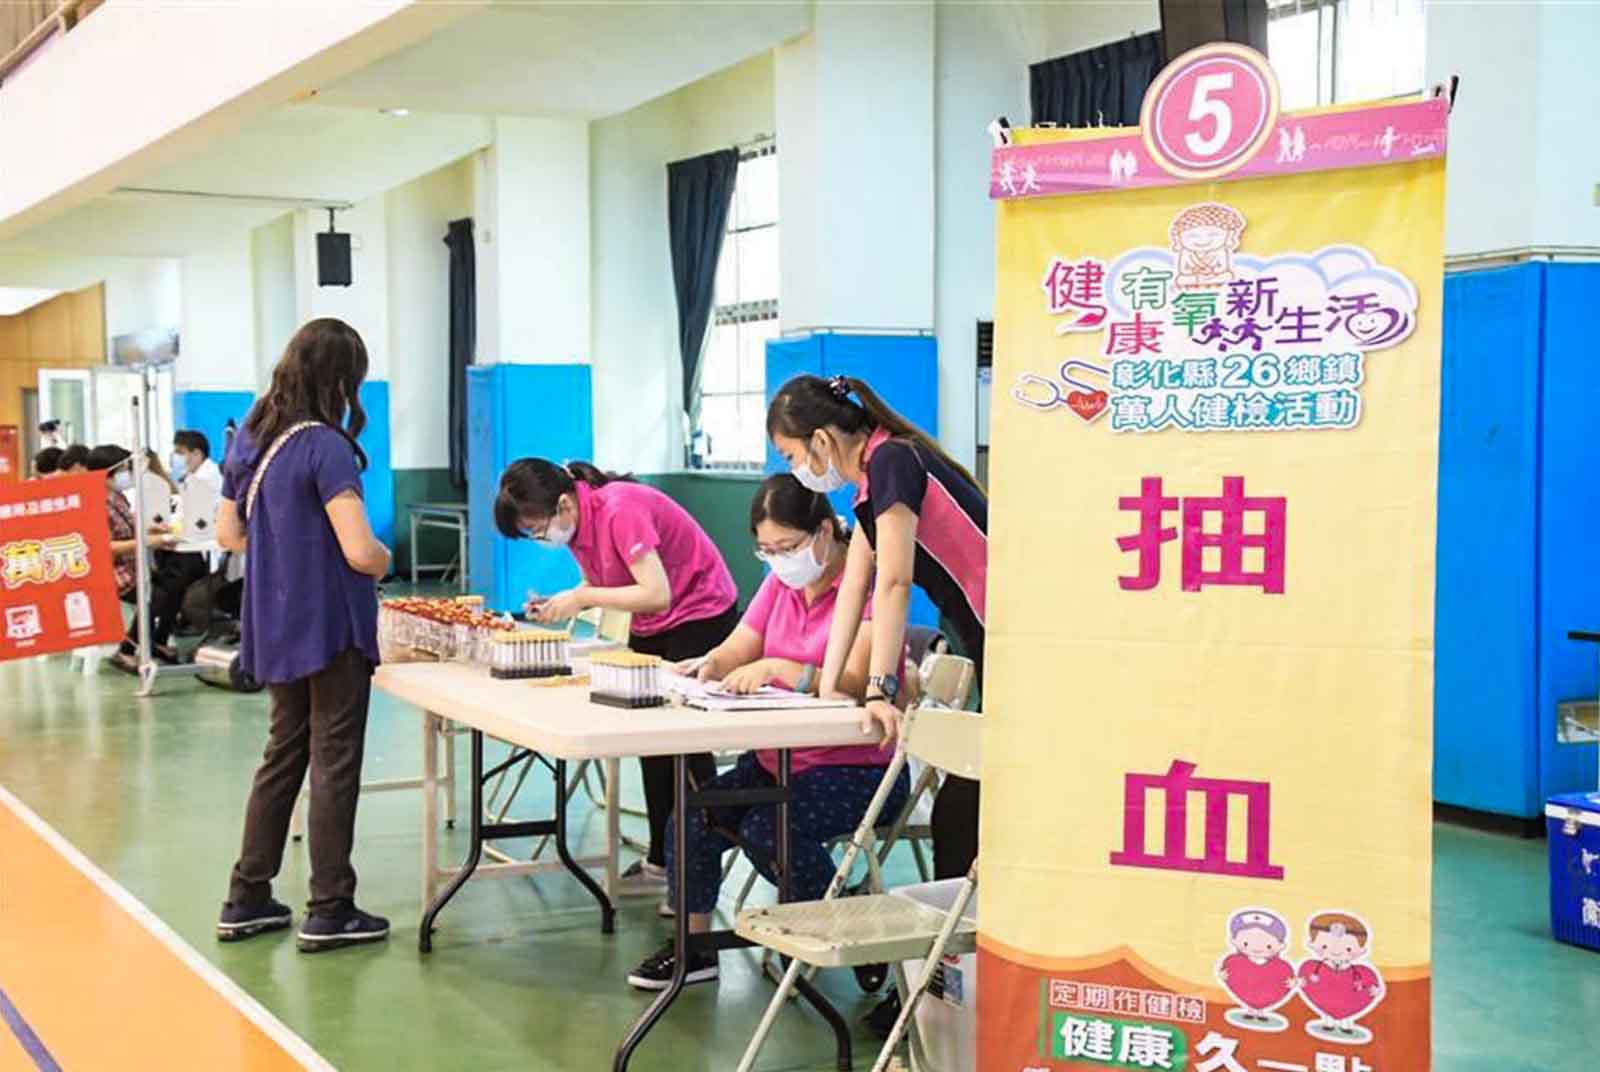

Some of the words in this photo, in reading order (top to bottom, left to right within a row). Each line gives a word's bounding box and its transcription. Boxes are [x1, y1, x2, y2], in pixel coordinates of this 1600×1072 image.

[1184, 73, 1233, 155] 5
[1112, 390, 1360, 428] 萬人健檢活動
[2, 536, 87, 585] 萬元
[1052, 981, 1205, 1022] 定期作健檢
